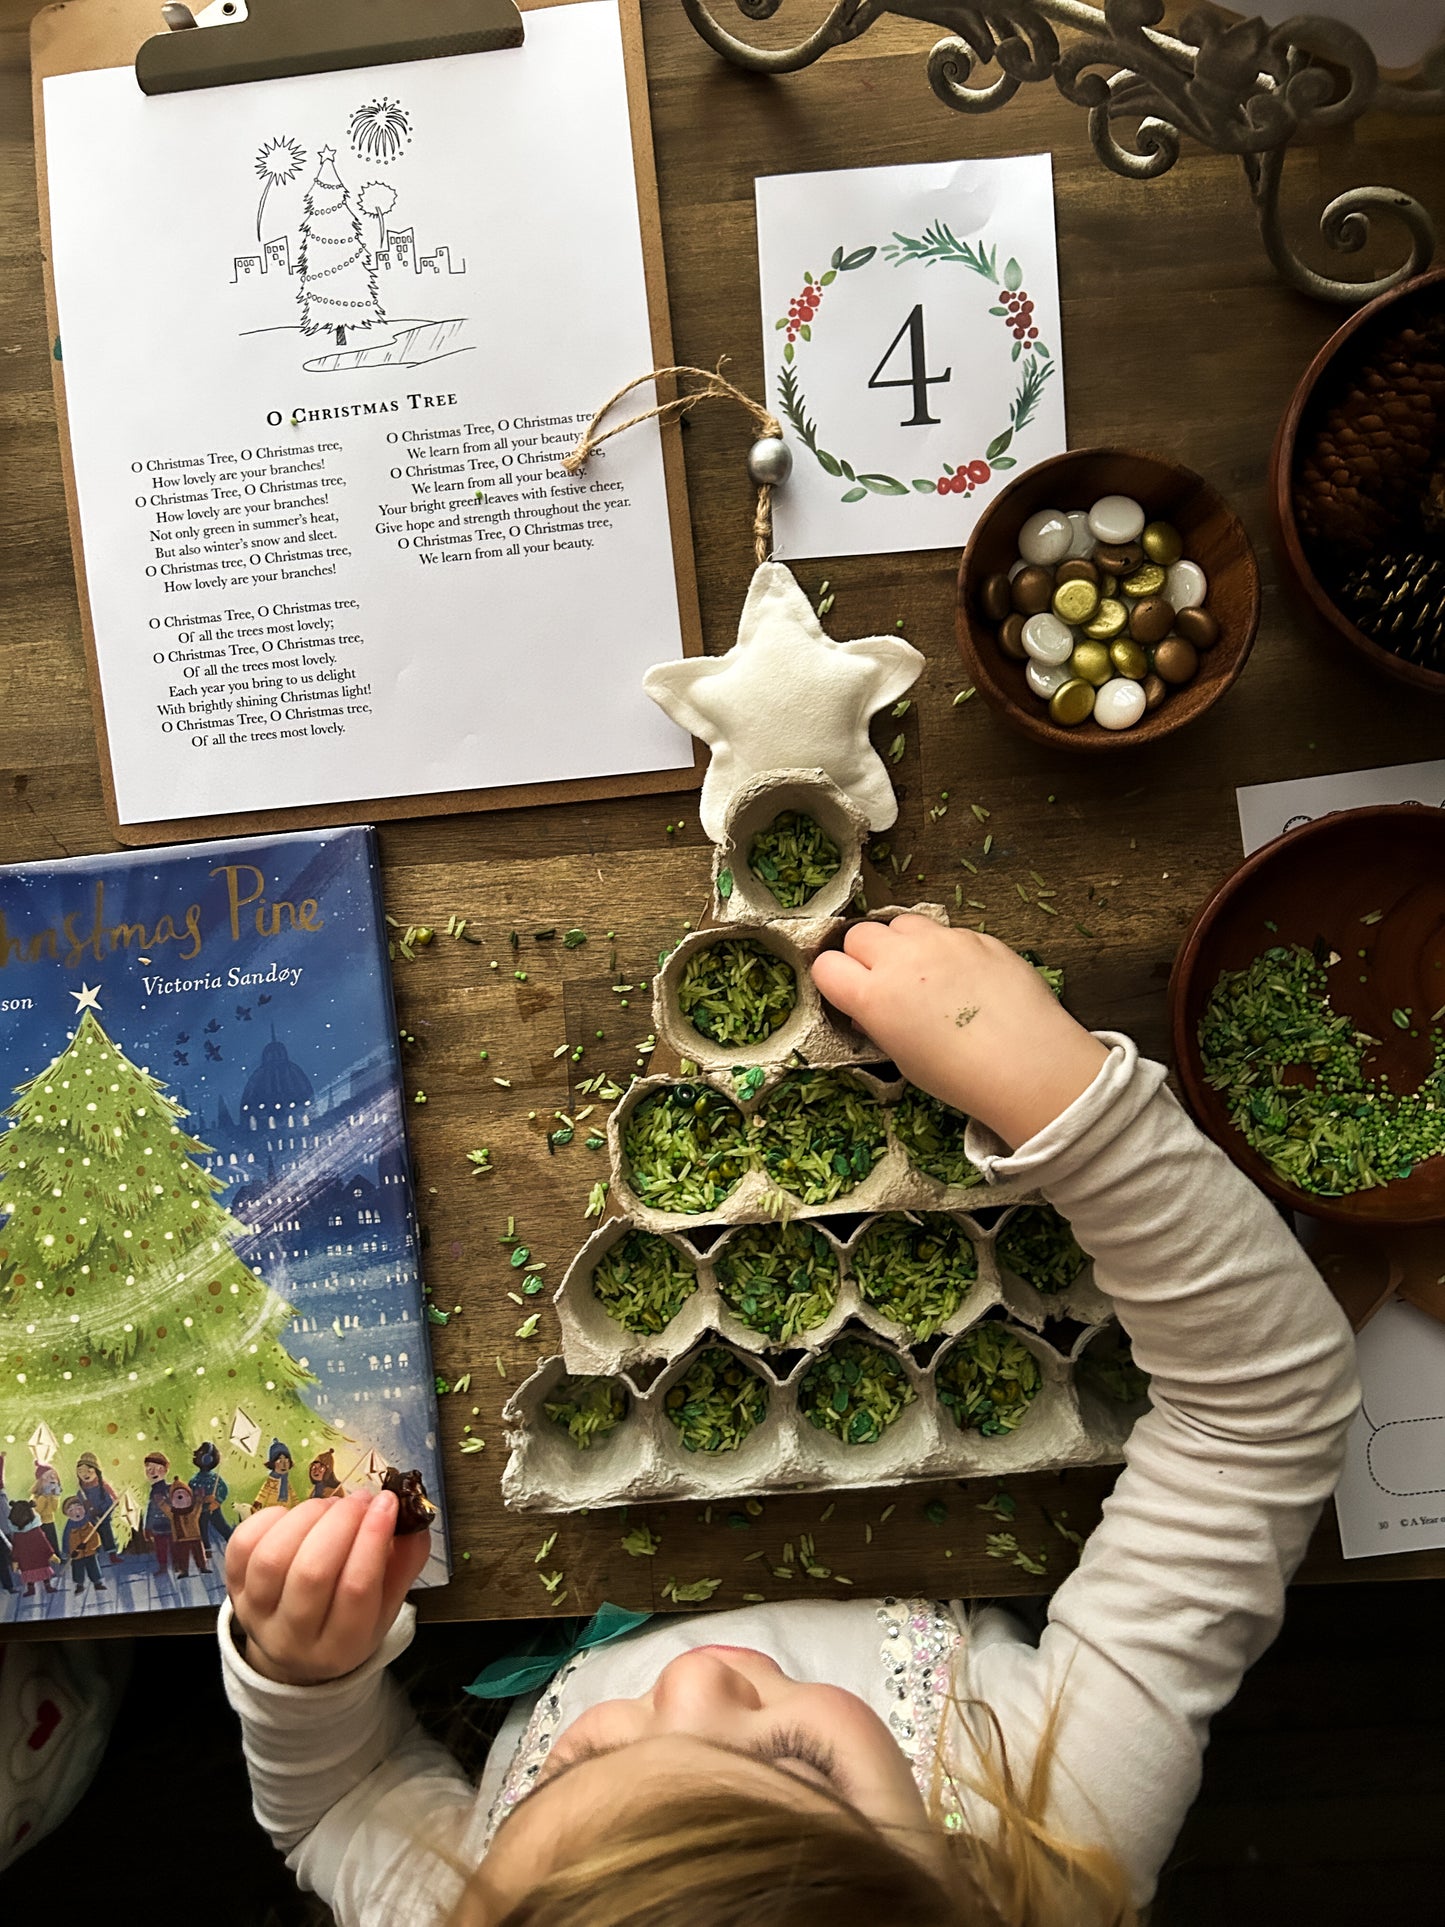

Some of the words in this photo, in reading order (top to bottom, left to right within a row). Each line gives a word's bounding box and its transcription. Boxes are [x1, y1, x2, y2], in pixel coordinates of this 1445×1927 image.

[868, 304, 951, 426] 4
[267, 411, 282, 426] O
[292, 400, 399, 423] CHRISTMAS
[407, 394, 458, 409] TREE
[386, 433, 398, 444] O
[402, 430, 462, 443] Christmas
[464, 424, 495, 435] Tree,
[498, 420, 510, 431] O
[514, 416, 573, 429] Christmas
[132, 462, 143, 473] O
[147, 458, 205, 471] Christmas
[207, 453, 238, 464] Tree,
[241, 450, 252, 461] O
[256, 446, 315, 459] Christmas
[318, 443, 343, 452] tree,
[407, 448, 426, 459] We
[429, 446, 460, 457] learn
[463, 442, 491, 453] from
[494, 438, 508, 450] all
[511, 437, 538, 451] your
[152, 477, 181, 489] How
[183, 472, 216, 486] lovely
[220, 472, 237, 481] are
[240, 469, 267, 482] your
[270, 459, 325, 475] branches!
[390, 468, 402, 479] O
[406, 464, 465, 477] Christmas
[468, 459, 499, 470] Tree,
[502, 455, 513, 466] O
[135, 497, 147, 508] O
[150, 493, 209, 506] Christmas
[211, 488, 241, 499] Tree,
[244, 484, 256, 495] O
[260, 480, 318, 494] Christmas
[321, 478, 346, 487] tree,
[411, 482, 431, 494] We
[434, 481, 465, 492] learn
[468, 477, 496, 489] from
[499, 473, 513, 485] all
[516, 473, 543, 486] your
[156, 512, 184, 523] How
[187, 507, 220, 520] lovely
[224, 507, 241, 516] are
[244, 504, 271, 517] your
[274, 494, 329, 510] branches!
[378, 504, 407, 516] Your
[410, 499, 446, 514] bright
[449, 498, 482, 512] green
[484, 494, 519, 505] leaves
[522, 487, 547, 500] with
[551, 484, 586, 497] festive
[590, 481, 624, 492] cheer,
[150, 530, 173, 542] Not
[176, 526, 200, 540] only
[203, 525, 235, 539] green
[238, 521, 250, 532] in
[253, 514, 307, 530] summer’s
[310, 513, 339, 523] heat,
[376, 522, 403, 534] Give
[406, 520, 435, 533] hope
[438, 514, 461, 527] and
[464, 509, 511, 525] strength
[514, 504, 579, 519] throughout
[582, 500, 601, 512] the
[604, 499, 631, 512] year.
[155, 548, 176, 559] But
[179, 544, 201, 556] also
[204, 538, 248, 553] winter’s
[251, 538, 280, 548] snow
[284, 531, 306, 544] and
[309, 530, 337, 541] sleet.
[398, 538, 410, 549] O
[413, 534, 473, 548] Christmas
[474, 529, 506, 541] Tree,
[509, 526, 521, 537] O
[524, 522, 584, 535] Christmas
[588, 520, 613, 529] tree,
[146, 566, 157, 577] O
[161, 562, 219, 576] Christmas
[222, 560, 247, 569] tree,
[250, 554, 261, 565] O
[265, 550, 323, 564] Christmas
[326, 548, 352, 557] tree,
[419, 553, 438, 565] We
[442, 552, 472, 563] learn
[475, 548, 503, 559] from
[506, 544, 520, 556] all
[523, 544, 550, 557] your
[553, 539, 594, 550] beauty.
[164, 581, 192, 593] How
[195, 576, 228, 590] lovely
[231, 577, 249, 585] are
[252, 573, 278, 587] your
[281, 564, 336, 579] branches!
[149, 618, 161, 629] O
[164, 614, 222, 628] Christmas
[224, 609, 255, 621] Tree,
[258, 606, 269, 617] O
[273, 602, 332, 616] Christmas
[335, 600, 360, 609] tree,
[178, 632, 195, 643] Of
[199, 630, 213, 642] all
[216, 628, 234, 640] the
[237, 628, 264, 637] trees
[267, 624, 295, 634] most
[297, 618, 334, 632] lovely;
[153, 653, 165, 664] O
[168, 649, 226, 663] Christmas
[228, 644, 259, 656] Tree,
[262, 641, 273, 652] O
[277, 638, 336, 651] Christmas
[339, 635, 364, 644] tree,
[184, 666, 201, 678] Of
[204, 664, 218, 676] all
[221, 663, 239, 674] the
[242, 663, 269, 672] trees
[272, 658, 300, 669] most
[302, 653, 337, 667] lovely.
[169, 684, 198, 697] Each
[201, 685, 226, 697] year
[228, 682, 249, 695] you
[252, 676, 283, 689] bring
[286, 677, 298, 685] to
[301, 676, 314, 684] us
[316, 668, 356, 683] delight
[157, 704, 186, 715] With
[188, 698, 233, 715] brightly
[236, 694, 278, 708] shining
[281, 690, 339, 703] Christmas
[342, 684, 371, 699] light!
[162, 722, 173, 733] O
[177, 718, 235, 732] Christmas
[237, 714, 267, 725] Tree,
[270, 710, 282, 722] O
[285, 707, 344, 720] Christmas
[347, 705, 372, 714] tree,
[192, 735, 209, 747] Of
[212, 734, 226, 745] all
[230, 732, 247, 743] the
[251, 732, 277, 741] trees
[280, 728, 308, 738] most
[310, 722, 345, 736] lovely.
[208, 864, 324, 941] Pine
[142, 973, 222, 996] Victoria
[228, 963, 303, 987] Sandøy
